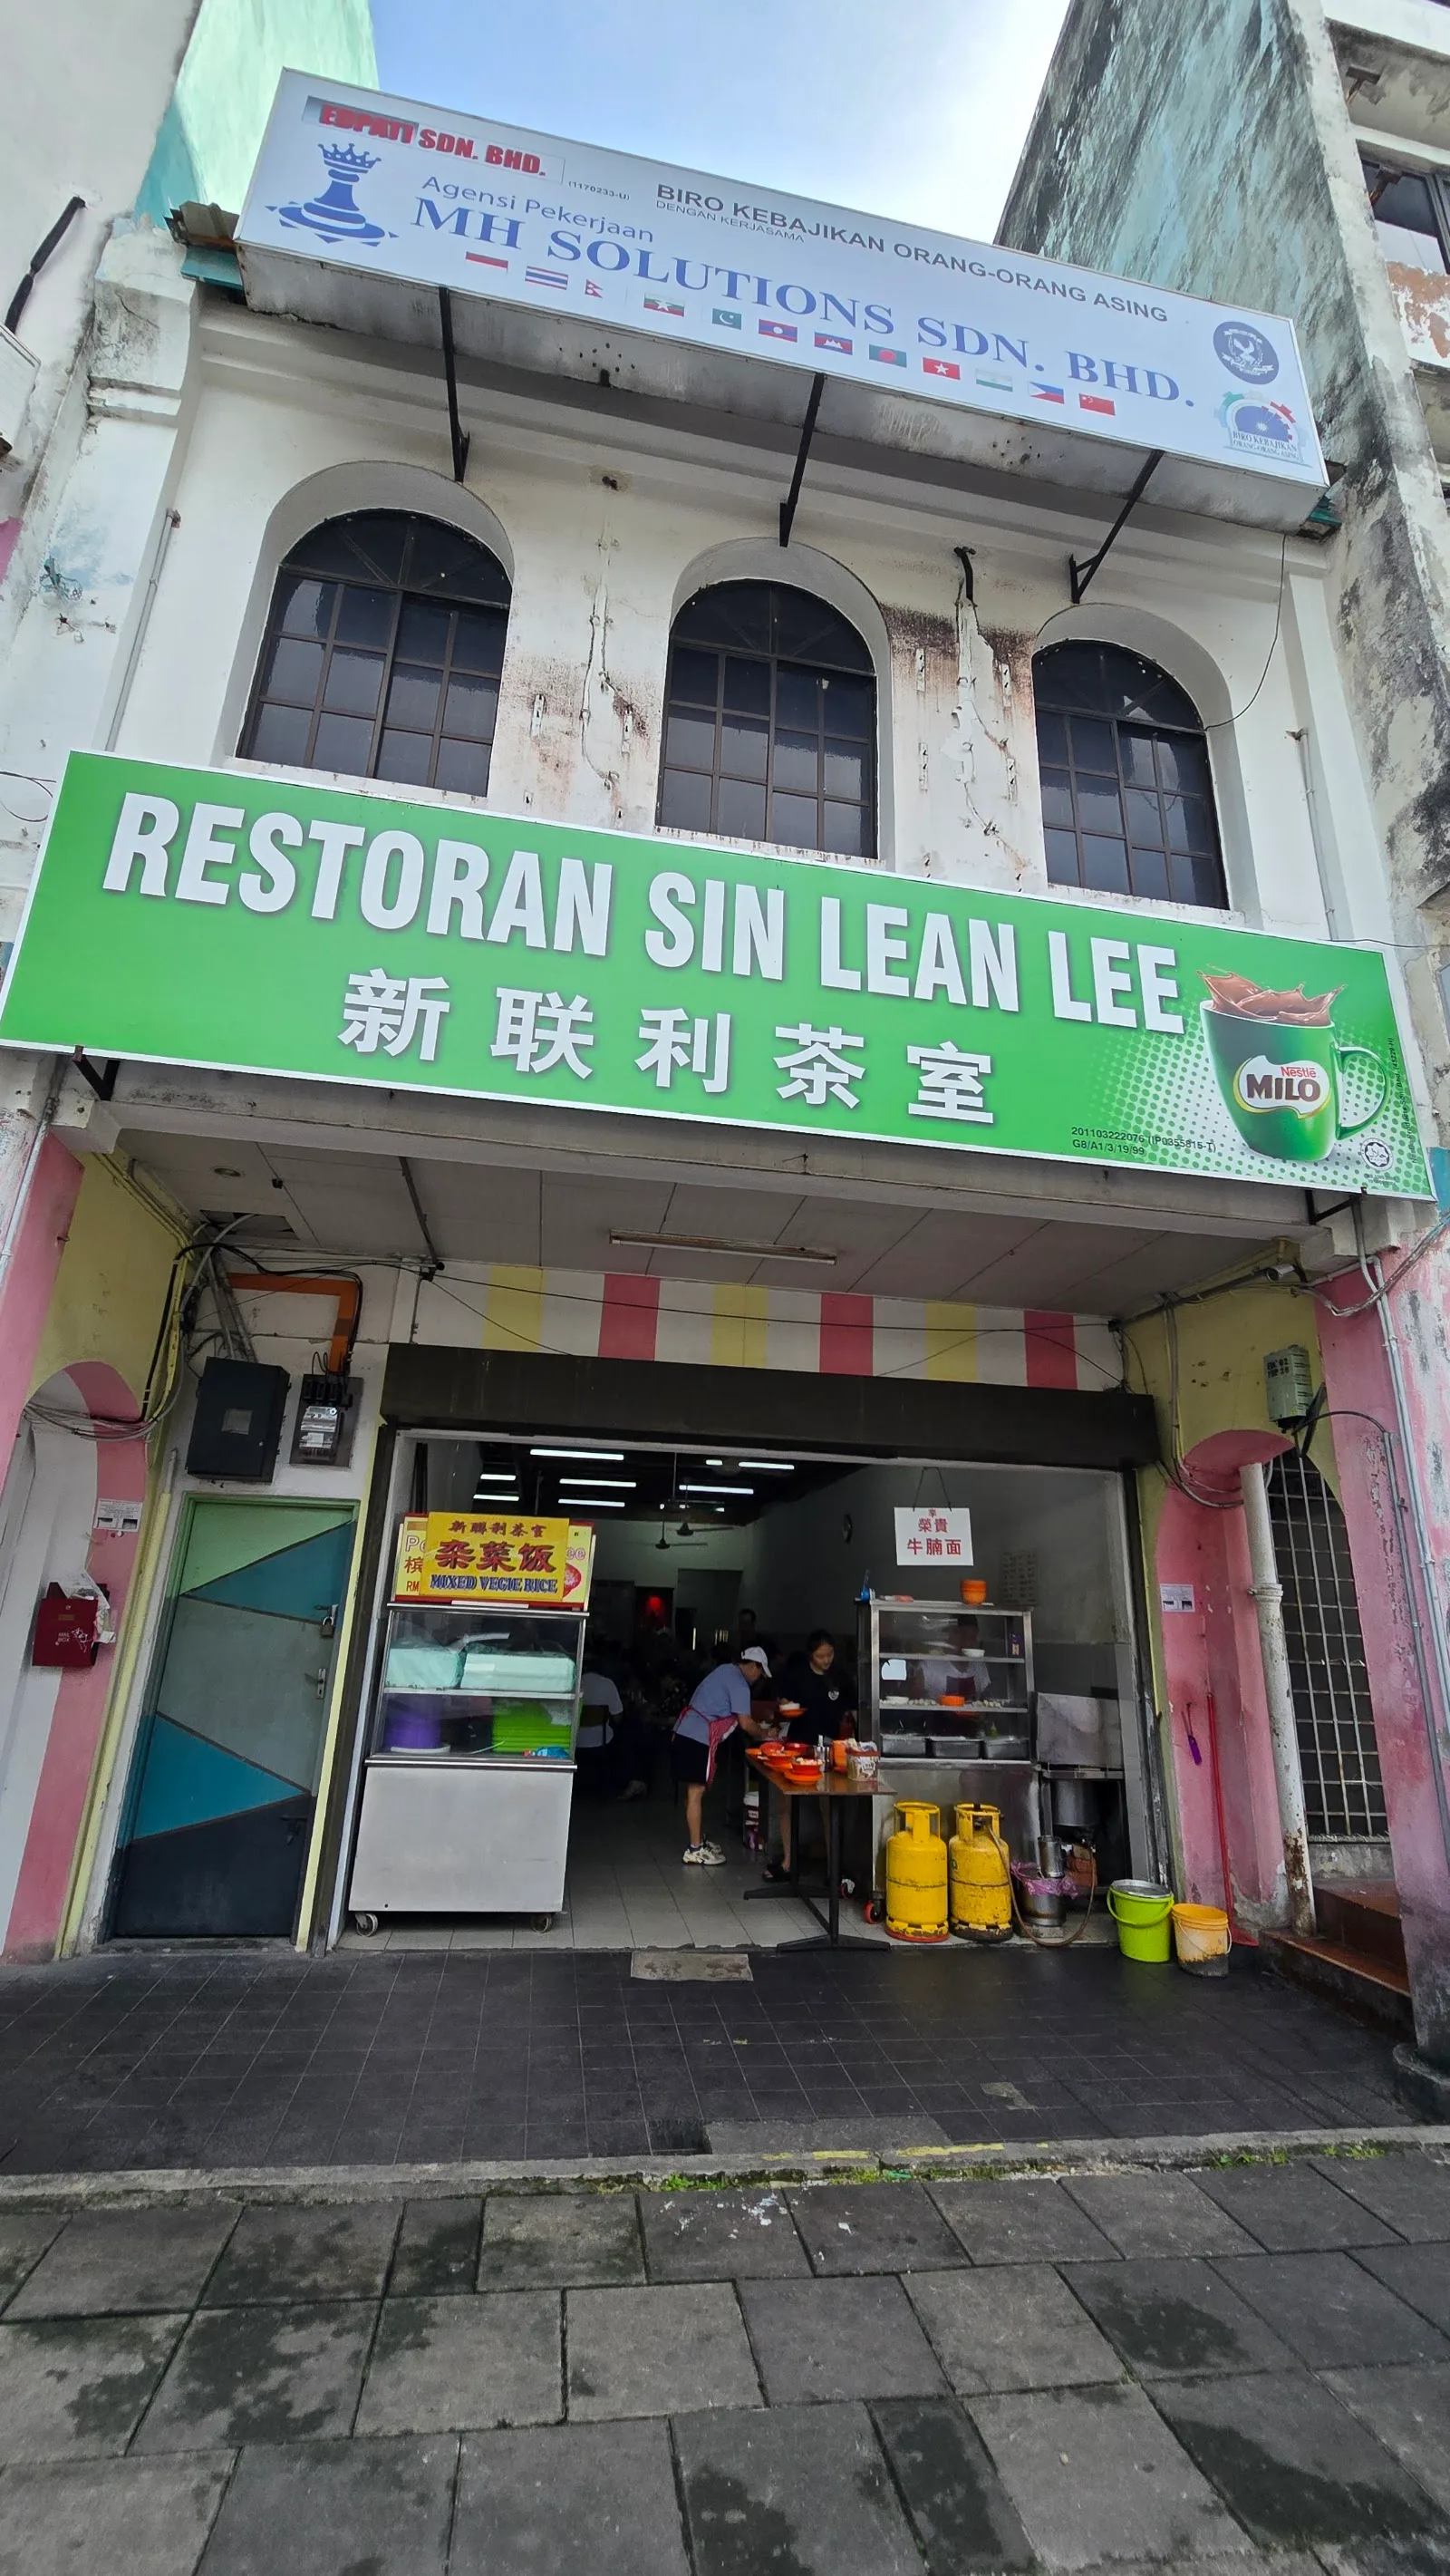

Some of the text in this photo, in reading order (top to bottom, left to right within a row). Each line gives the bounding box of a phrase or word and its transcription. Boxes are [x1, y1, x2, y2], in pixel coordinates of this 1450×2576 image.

[419, 128, 478, 160] SDN.
[485, 145, 546, 176] BHD.
[568, 180, 631, 200] (1170233-U)
[421, 176, 653, 242] Agensi Pekerjaan
[656, 200, 805, 243] DENGAN KERJASAMA
[657, 184, 1168, 323] BIRO KEBAJIKAN ORANG-ORANG ASING
[411, 197, 526, 249] MH
[547, 229, 894, 334] SOLUTIONS
[917, 316, 1044, 372] SDN.
[1067, 351, 1194, 407] BHD.
[1232, 431, 1297, 451] BIRO KEBAJIKAN
[102, 791, 1184, 1034] RESTORAN SIN LEAN LEE
[338, 967, 995, 1124] 新联利茶室
[1246, 1074, 1320, 1102] MILO
[1071, 1127, 1145, 1143] 201103222076
[1072, 1138, 1145, 1156] G8/A1/3/19/99
[435, 1539, 556, 1574] 杂菜饭
[907, 1537, 962, 1555] 牛腩面
[430, 1574, 558, 1593] MIXED VEGIE RICE
